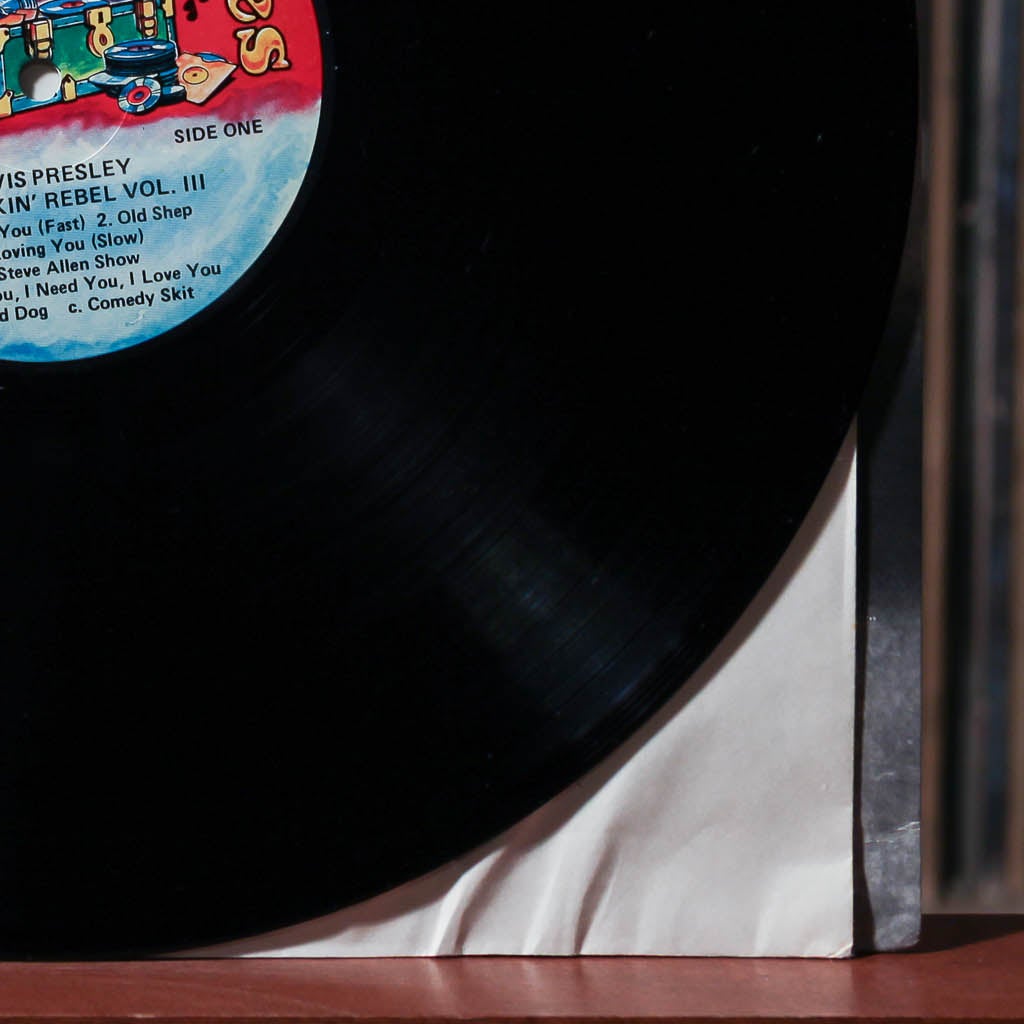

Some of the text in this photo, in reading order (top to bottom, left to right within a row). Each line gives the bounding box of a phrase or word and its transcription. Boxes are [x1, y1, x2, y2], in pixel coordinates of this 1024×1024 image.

[174, 119, 263, 143] SIDE ONE
[32, 158, 131, 185] PRESLEY
[45, 185, 116, 209] REBEL
[123, 178, 175, 199] VOL.
[183, 173, 206, 192] III
[38, 215, 85, 236] (Fast)
[97, 213, 112, 227] 2.
[118, 208, 147, 225] Old
[152, 205, 192, 221] Shep
[51, 238, 85, 254] You
[92, 228, 144, 250] (Slow)
[47, 258, 89, 275] Allen
[95, 253, 140, 269] Show
[25, 284, 30, 298] I
[37, 279, 78, 298] Need
[84, 276, 124, 290] You,
[129, 271, 135, 285] I
[142, 269, 181, 284] Love
[186, 263, 221, 277] You
[15, 306, 48, 321] Dog
[68, 303, 82, 314] c.
[88, 291, 154, 311] Comedy
[161, 286, 194, 302] Skit
